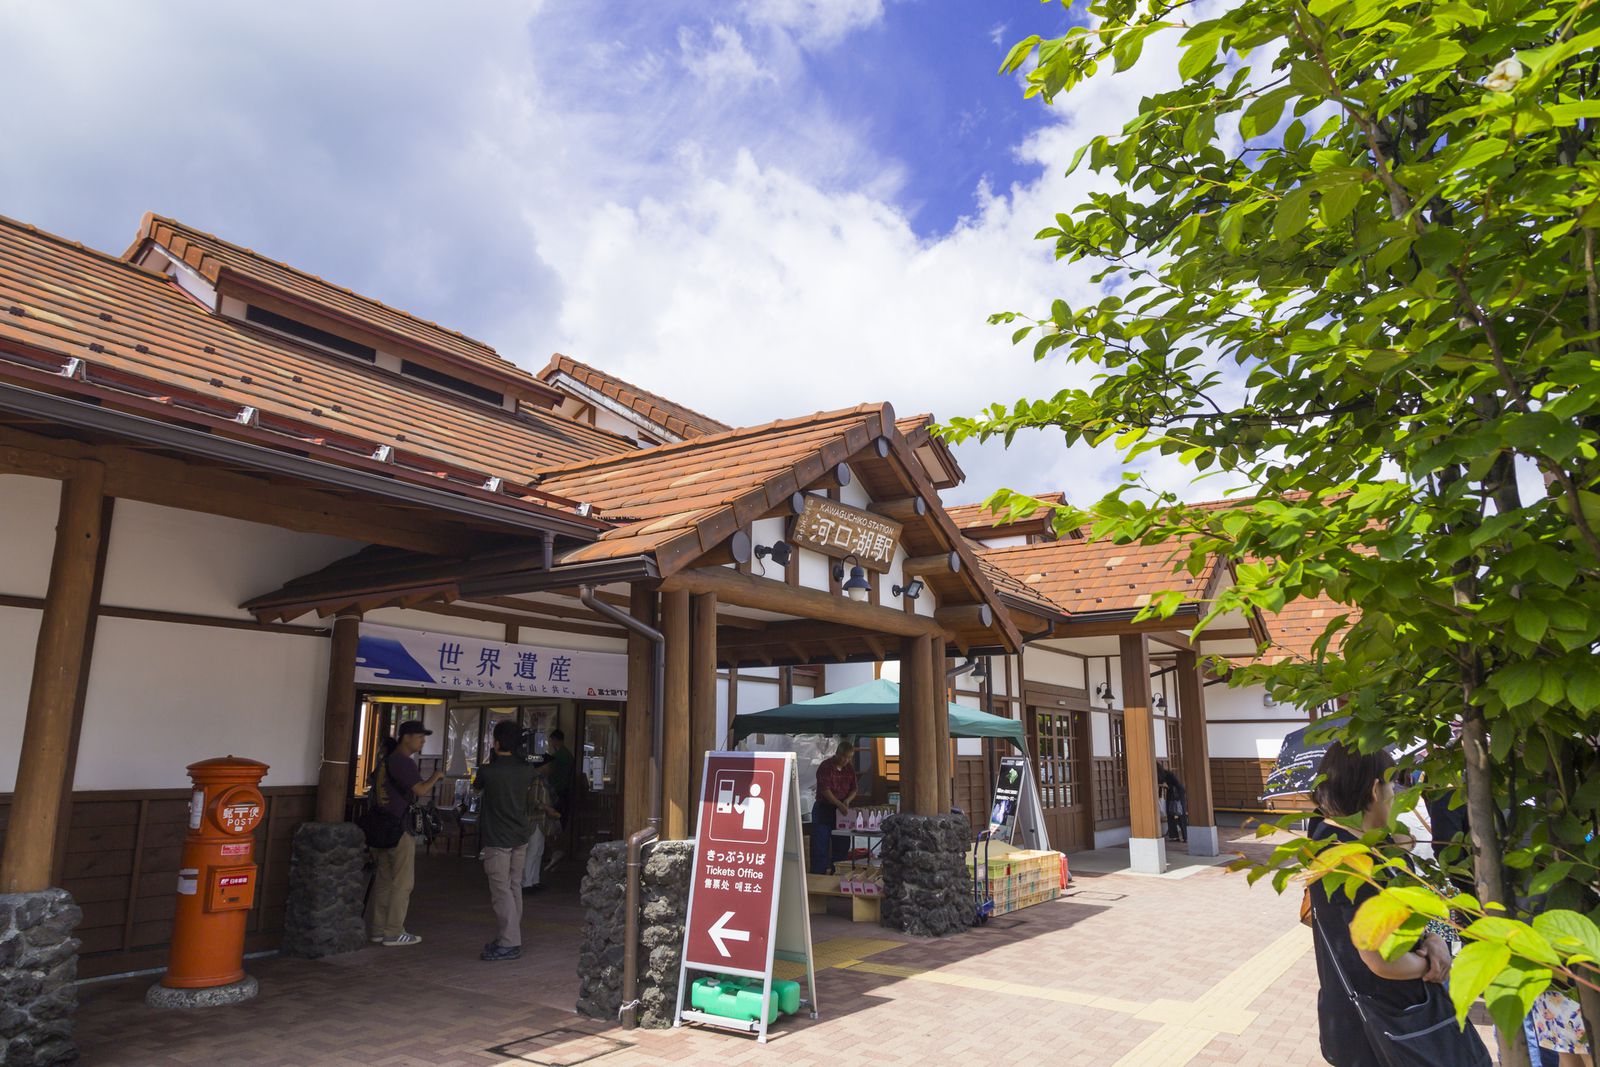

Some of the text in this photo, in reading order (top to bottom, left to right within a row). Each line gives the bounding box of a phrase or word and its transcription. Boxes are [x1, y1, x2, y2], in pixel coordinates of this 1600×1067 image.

[820, 504, 867, 526] KAWAGUCHIKO
[867, 520, 895, 535] STATION
[809, 514, 894, 563] 河口湖駅
[438, 642, 571, 682] 世界遺産
[440, 676, 576, 694] これからも、富士山と共に。
[227, 817, 254, 827] POST
[706, 849, 766, 865] きっぷうりば
[705, 865, 764, 879] Tickets Office
